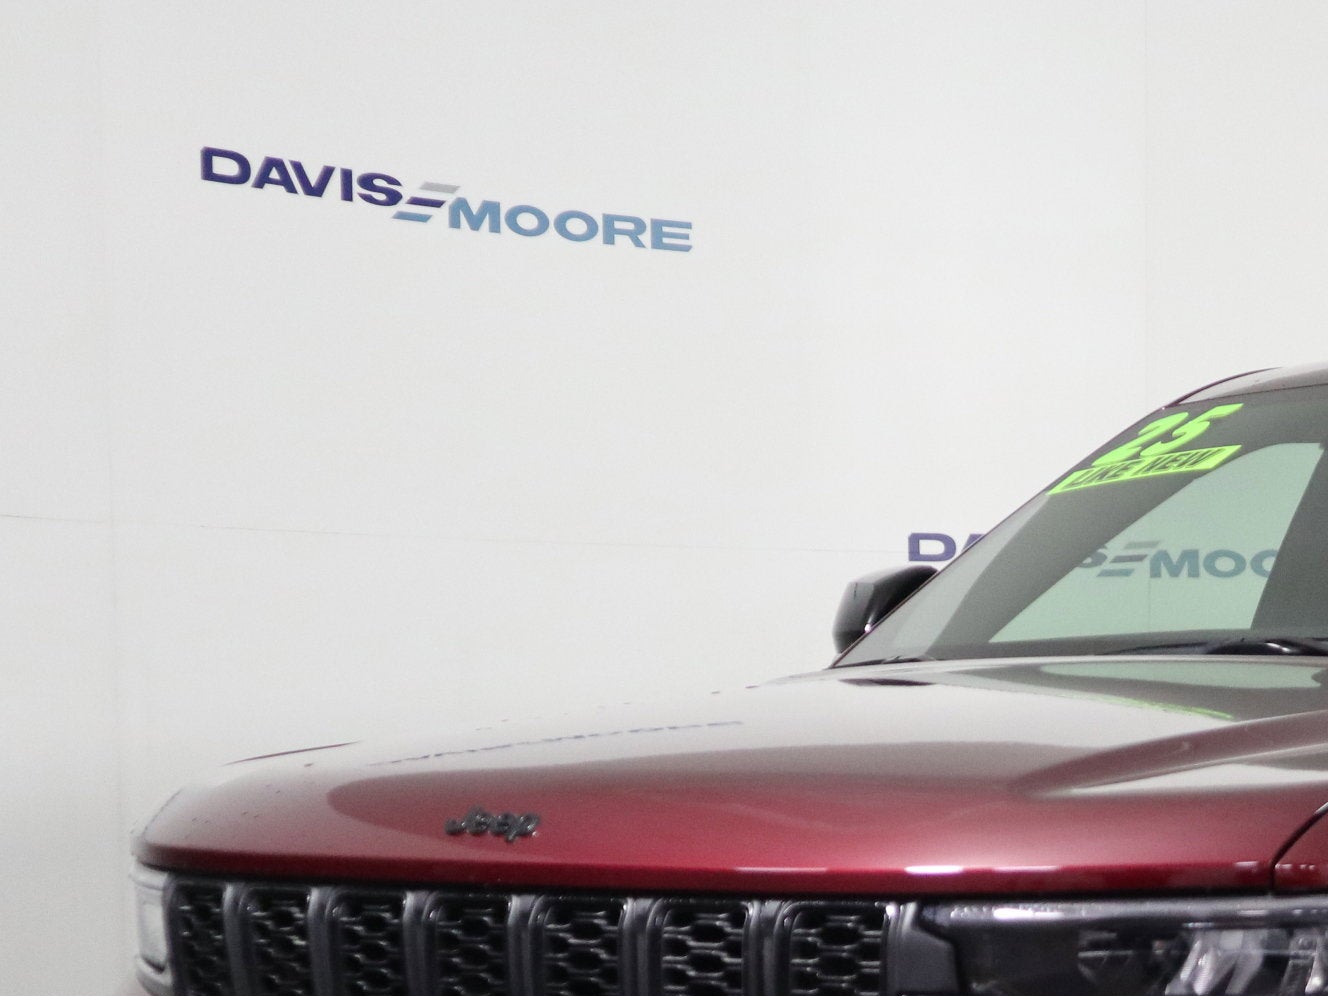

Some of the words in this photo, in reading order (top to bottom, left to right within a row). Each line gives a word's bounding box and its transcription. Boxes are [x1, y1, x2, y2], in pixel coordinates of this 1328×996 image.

[201, 147, 403, 206] DAVIS
[449, 197, 692, 252] MOORE
[1092, 403, 1244, 467] 25
[1064, 459, 1143, 487] LIKE
[1131, 448, 1226, 475] NEW
[445, 805, 540, 843] Jeep
